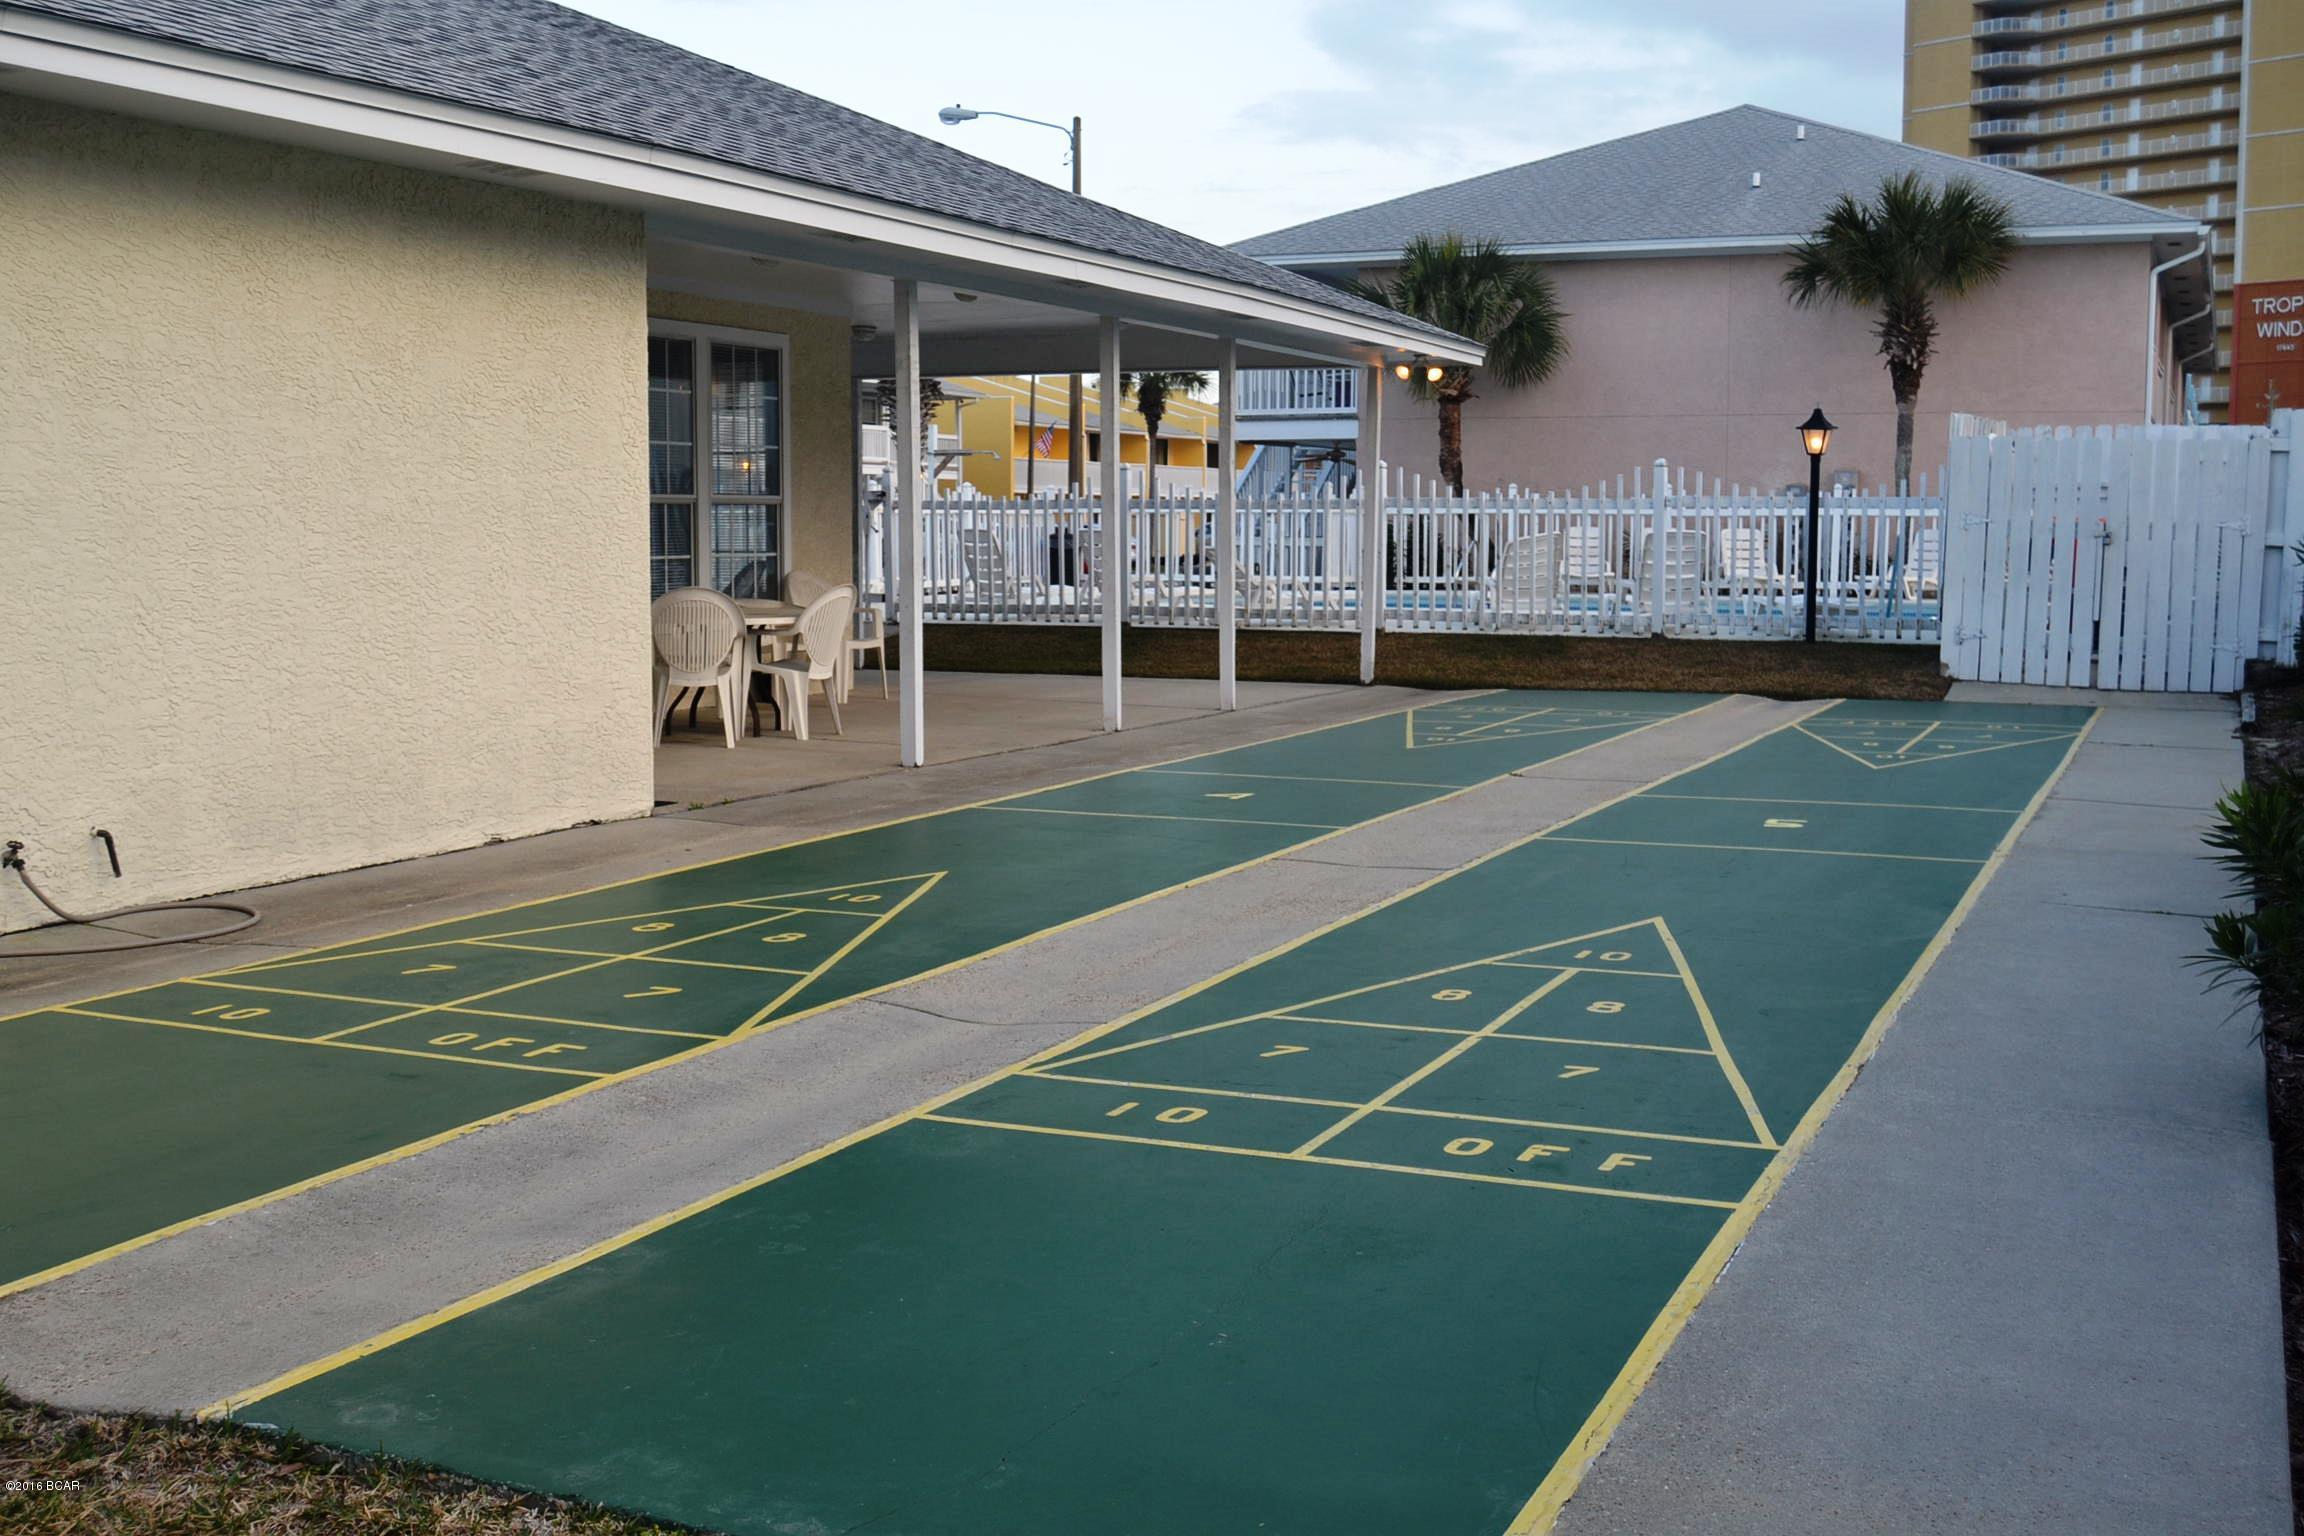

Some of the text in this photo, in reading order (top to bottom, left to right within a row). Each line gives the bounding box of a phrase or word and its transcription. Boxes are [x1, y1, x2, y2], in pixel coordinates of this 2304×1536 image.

[2256, 320, 2304, 338] WIND
[828, 893, 882, 903] 10
[631, 921, 676, 934] 8
[761, 932, 808, 944] 8
[1573, 949, 1633, 961] 10
[400, 962, 458, 976] 7
[623, 985, 683, 999] 7
[1430, 987, 1474, 1002] 8
[1585, 999, 1628, 1015] 8
[190, 1002, 589, 1059] 10 OFF
[1259, 1043, 1311, 1058] 7
[1556, 1064, 1601, 1080] 7
[1105, 1100, 1653, 1173] 10 OFF
